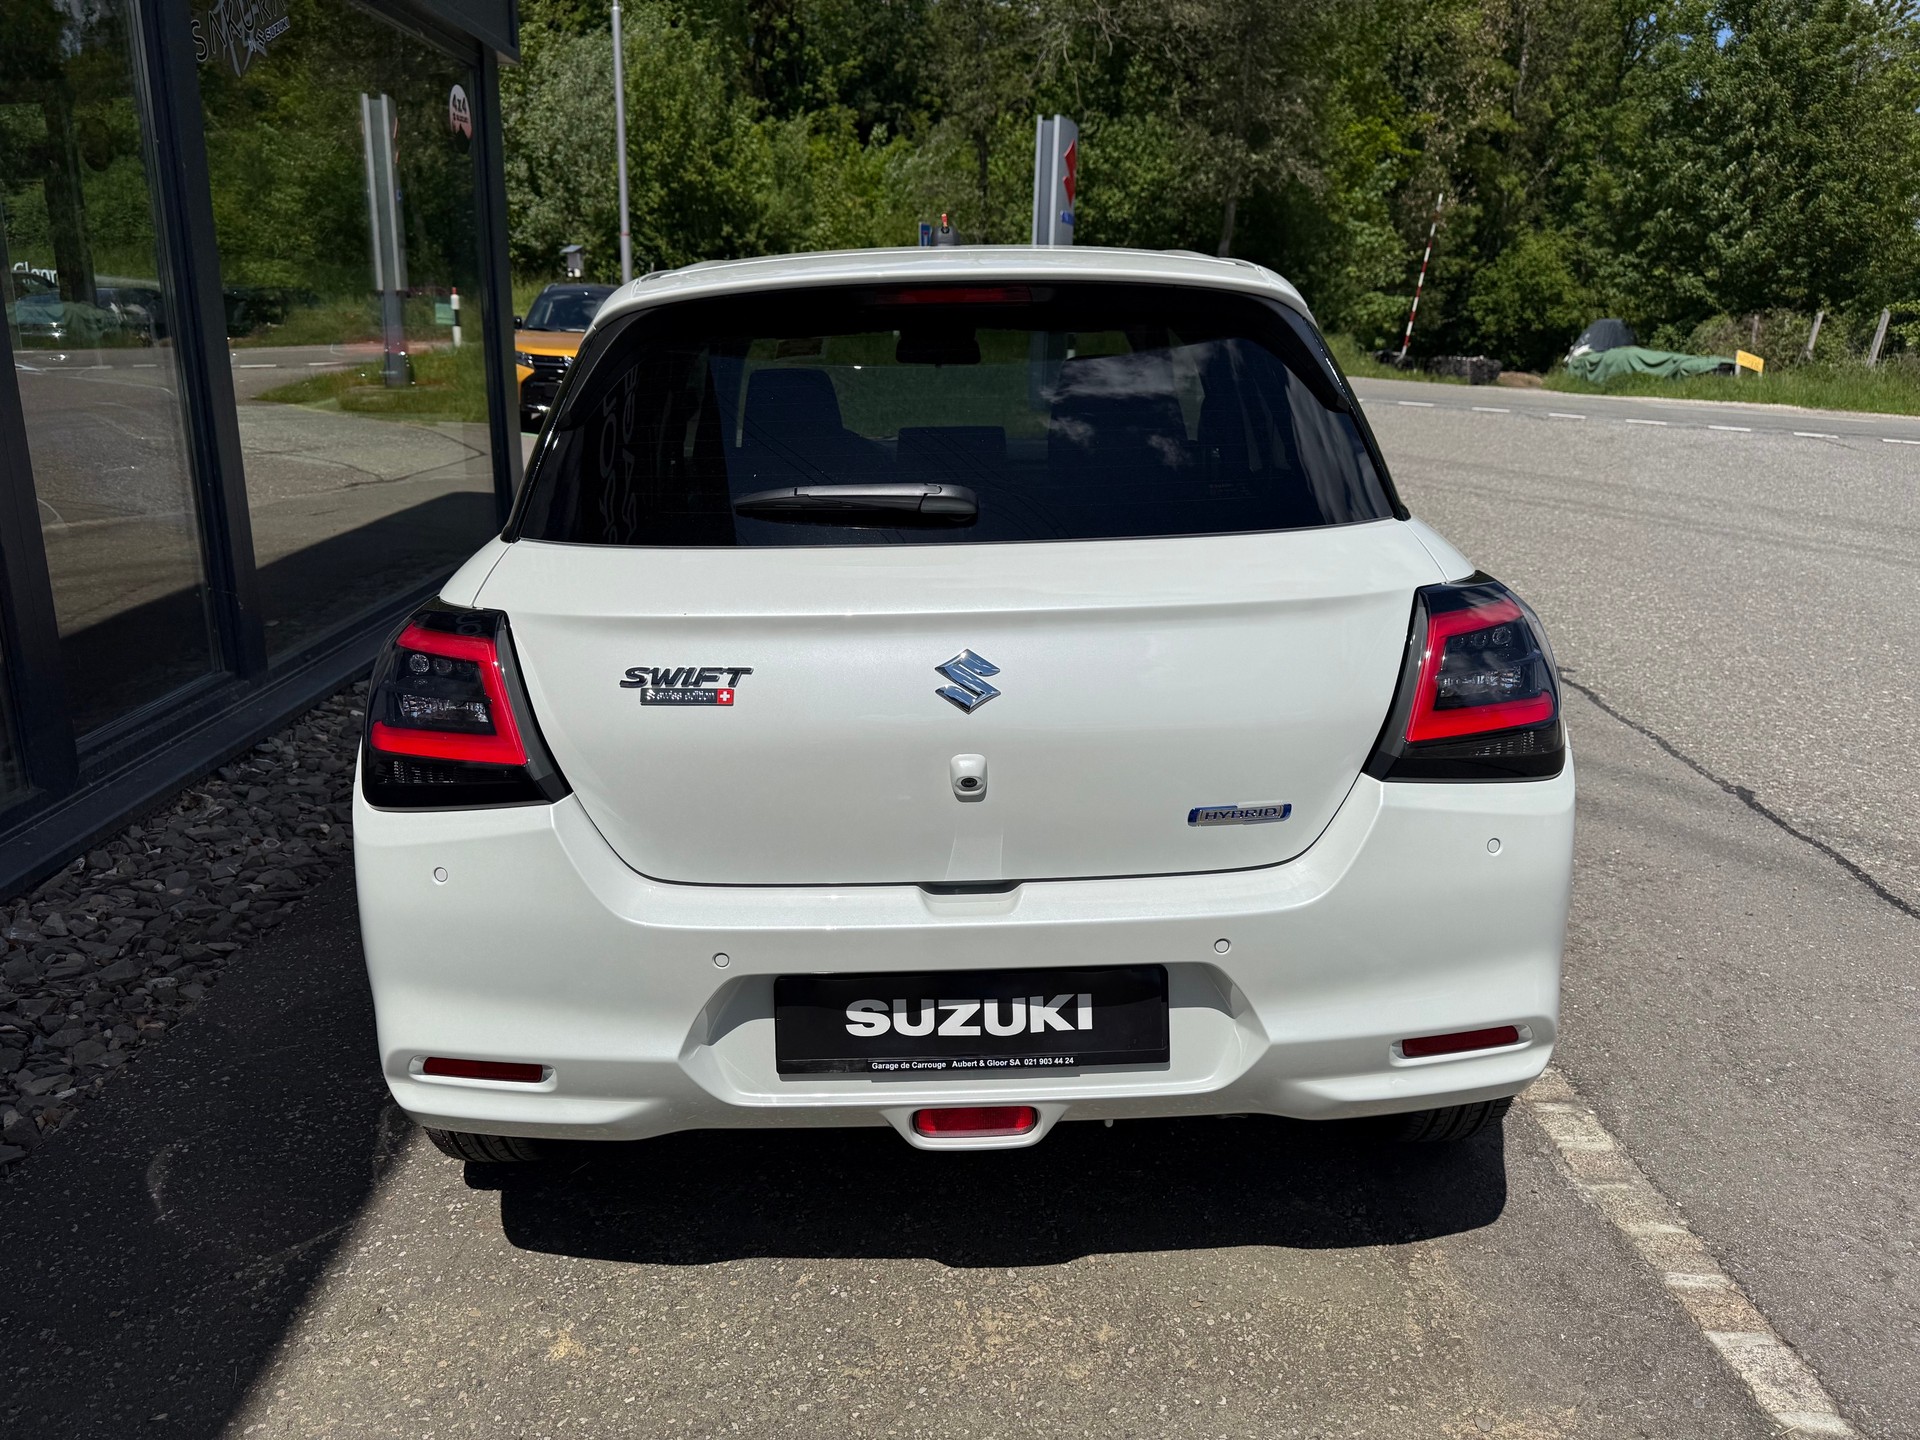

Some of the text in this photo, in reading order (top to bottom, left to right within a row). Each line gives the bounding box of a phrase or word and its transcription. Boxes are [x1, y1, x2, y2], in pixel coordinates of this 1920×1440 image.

[619, 666, 754, 688] SWIFT
[1204, 807, 1278, 820] HYBRID
[845, 993, 1093, 1037] SUZUKI
[871, 1056, 1074, 1071] Garage de Carrouge Aubert & Gloor SA 021 903 44 24
